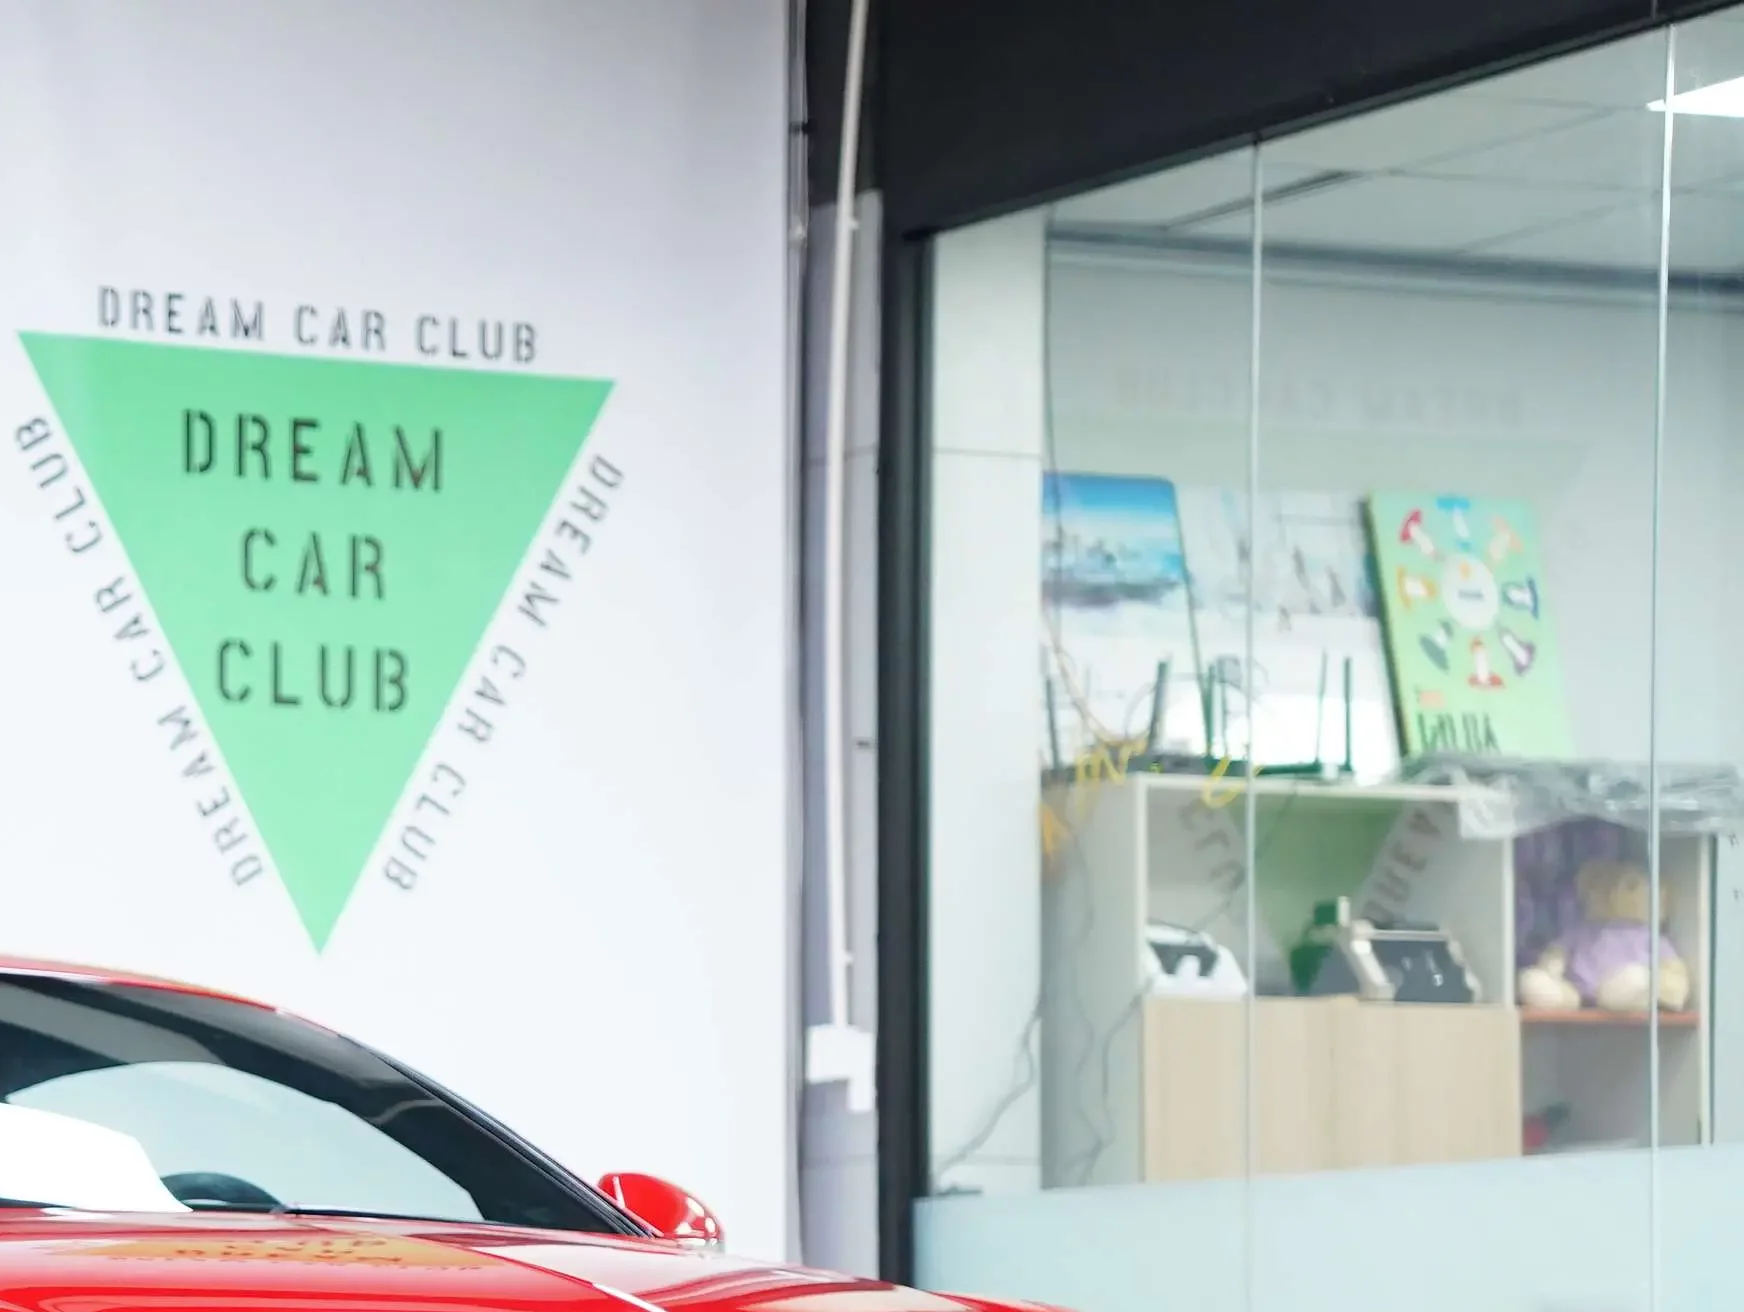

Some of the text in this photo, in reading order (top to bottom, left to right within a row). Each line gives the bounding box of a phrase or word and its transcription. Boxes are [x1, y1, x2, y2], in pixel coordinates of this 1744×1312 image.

[98, 285, 537, 364] DREAM CAR CLUB
[182, 408, 444, 493] DREAM
[242, 526, 386, 600] CAR
[15, 415, 264, 887] DREAM CAR CLUB
[216, 638, 410, 713] CLUB
[382, 454, 625, 891] DREAM CAR CLUB
